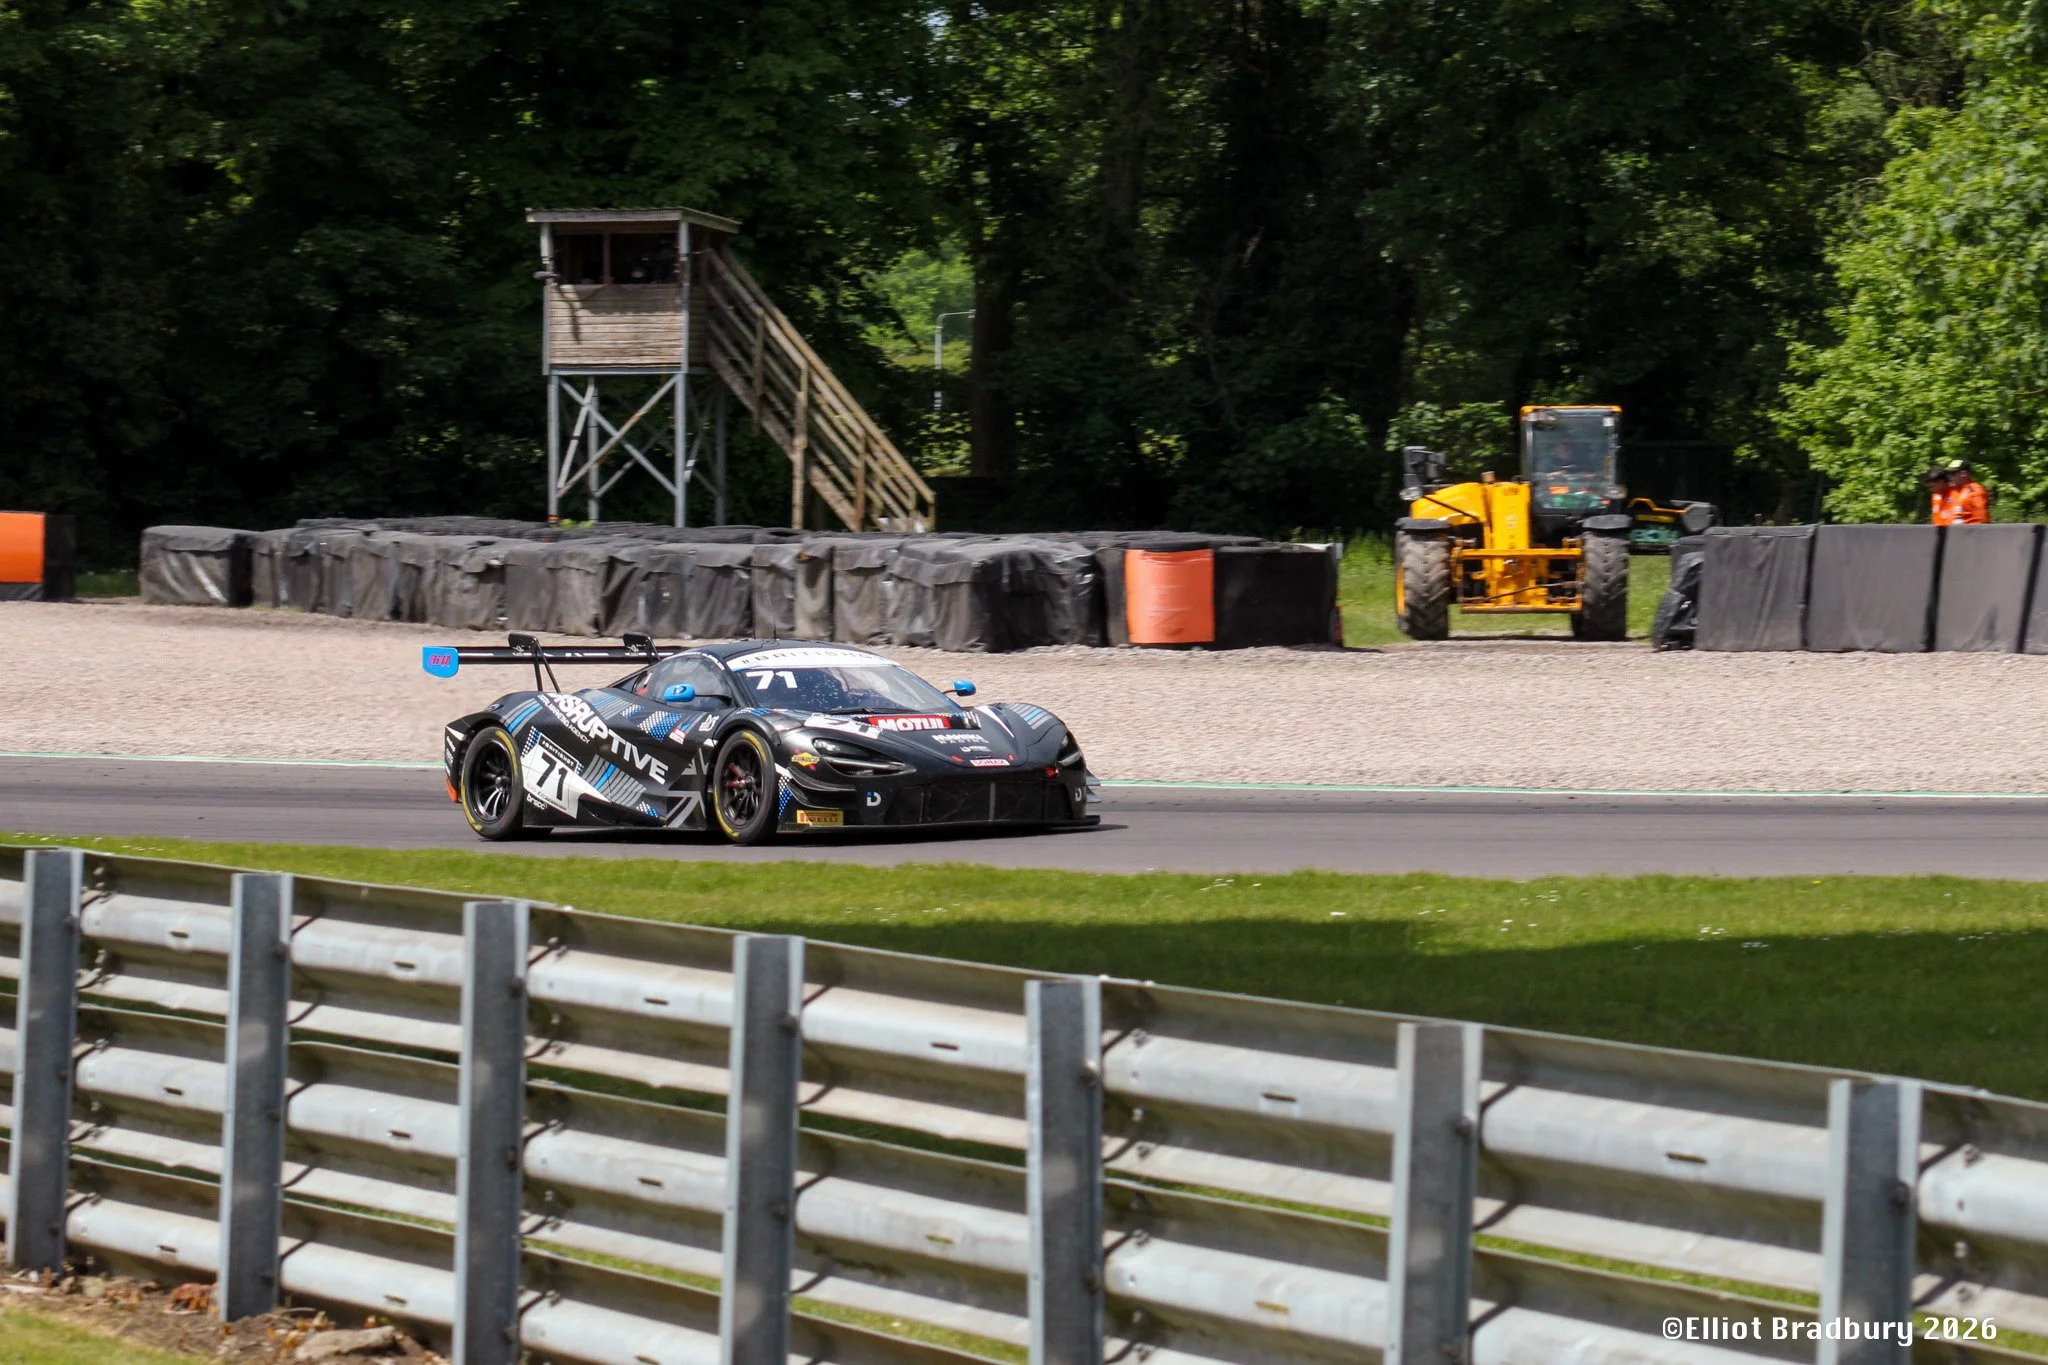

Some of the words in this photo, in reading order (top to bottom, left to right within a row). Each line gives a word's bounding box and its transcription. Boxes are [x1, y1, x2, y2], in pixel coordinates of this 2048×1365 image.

[746, 670, 797, 690] 71
[877, 717, 947, 732] MOTUL
[536, 752, 569, 801] 71
[800, 812, 839, 822] PIRELLI
